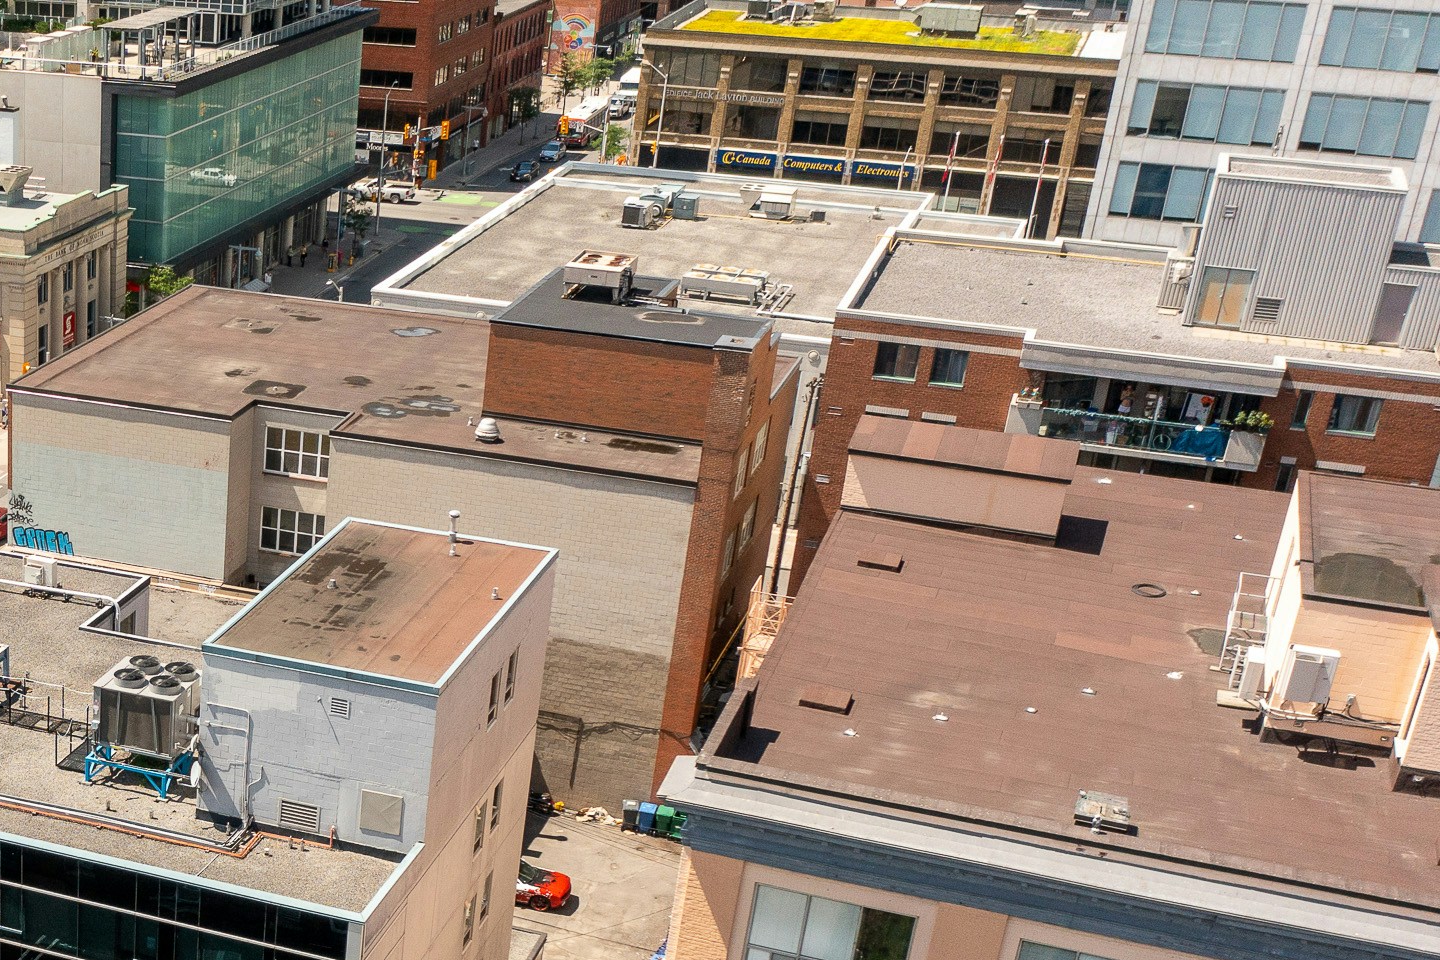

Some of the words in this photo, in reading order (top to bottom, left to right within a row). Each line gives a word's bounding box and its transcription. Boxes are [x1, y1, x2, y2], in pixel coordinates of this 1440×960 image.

[695, 89, 713, 99] Jack
[717, 91, 747, 103] Layton
[736, 152, 772, 166] Canada
[784, 158, 833, 172] Computers
[834, 163, 842, 172] &
[856, 165, 910, 178] Electronis
